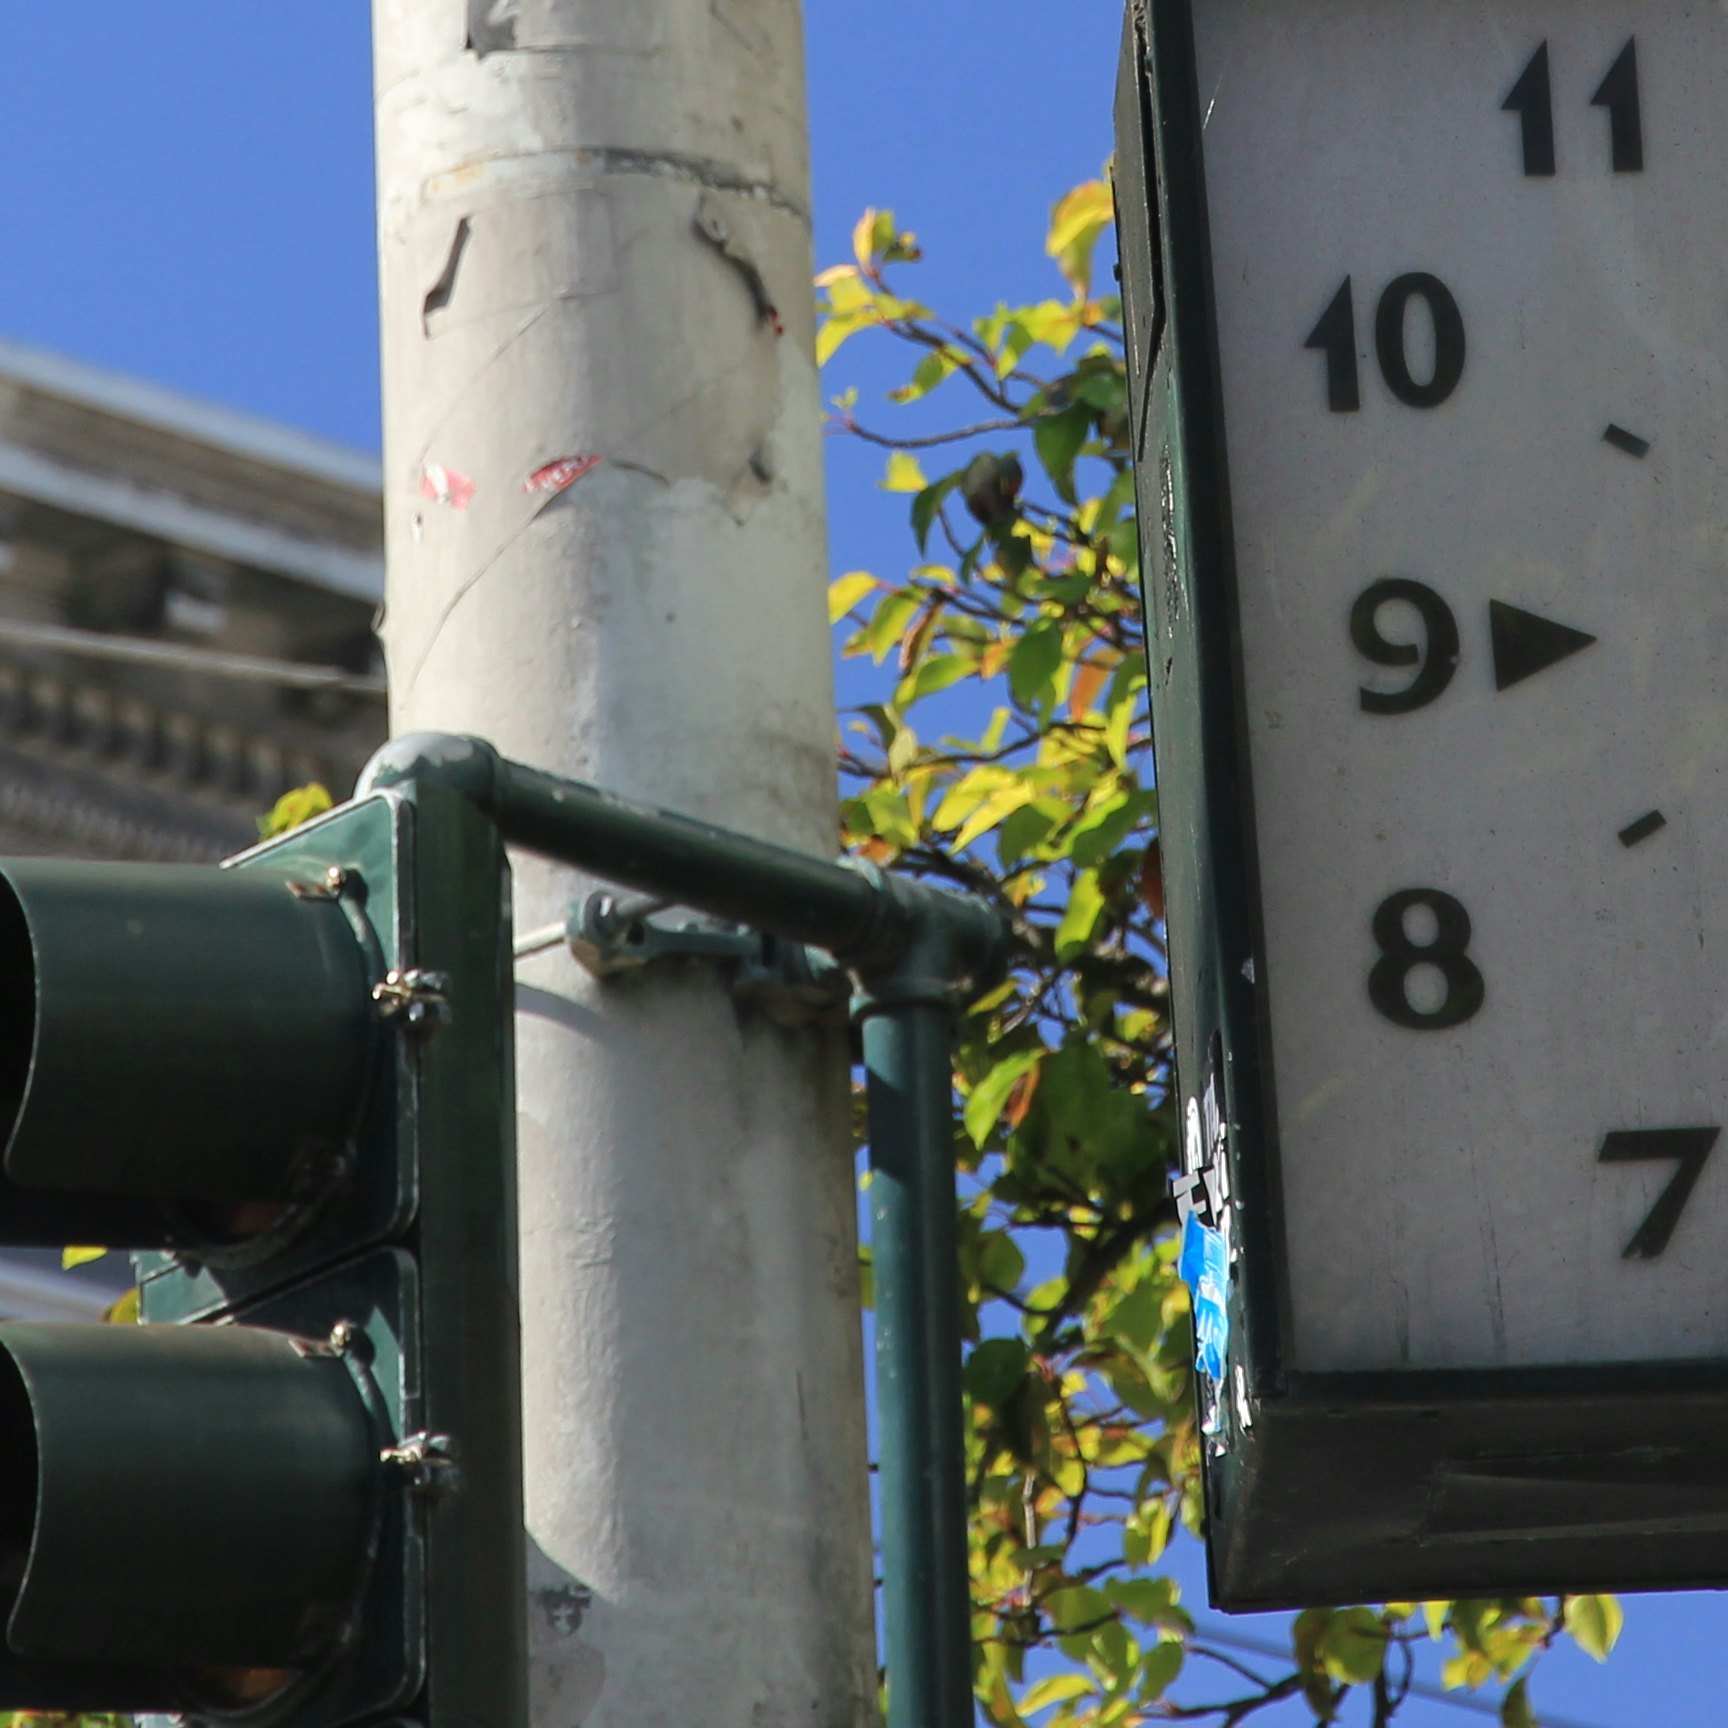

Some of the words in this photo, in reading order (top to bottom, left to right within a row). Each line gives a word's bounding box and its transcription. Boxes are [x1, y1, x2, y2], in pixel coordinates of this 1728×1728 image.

[1500, 34, 1644, 178] 11
[1303, 271, 1467, 414] 10
[1348, 577, 1461, 716] 9
[1366, 887, 1486, 1032] 8
[1597, 1125, 1722, 1262] 7
